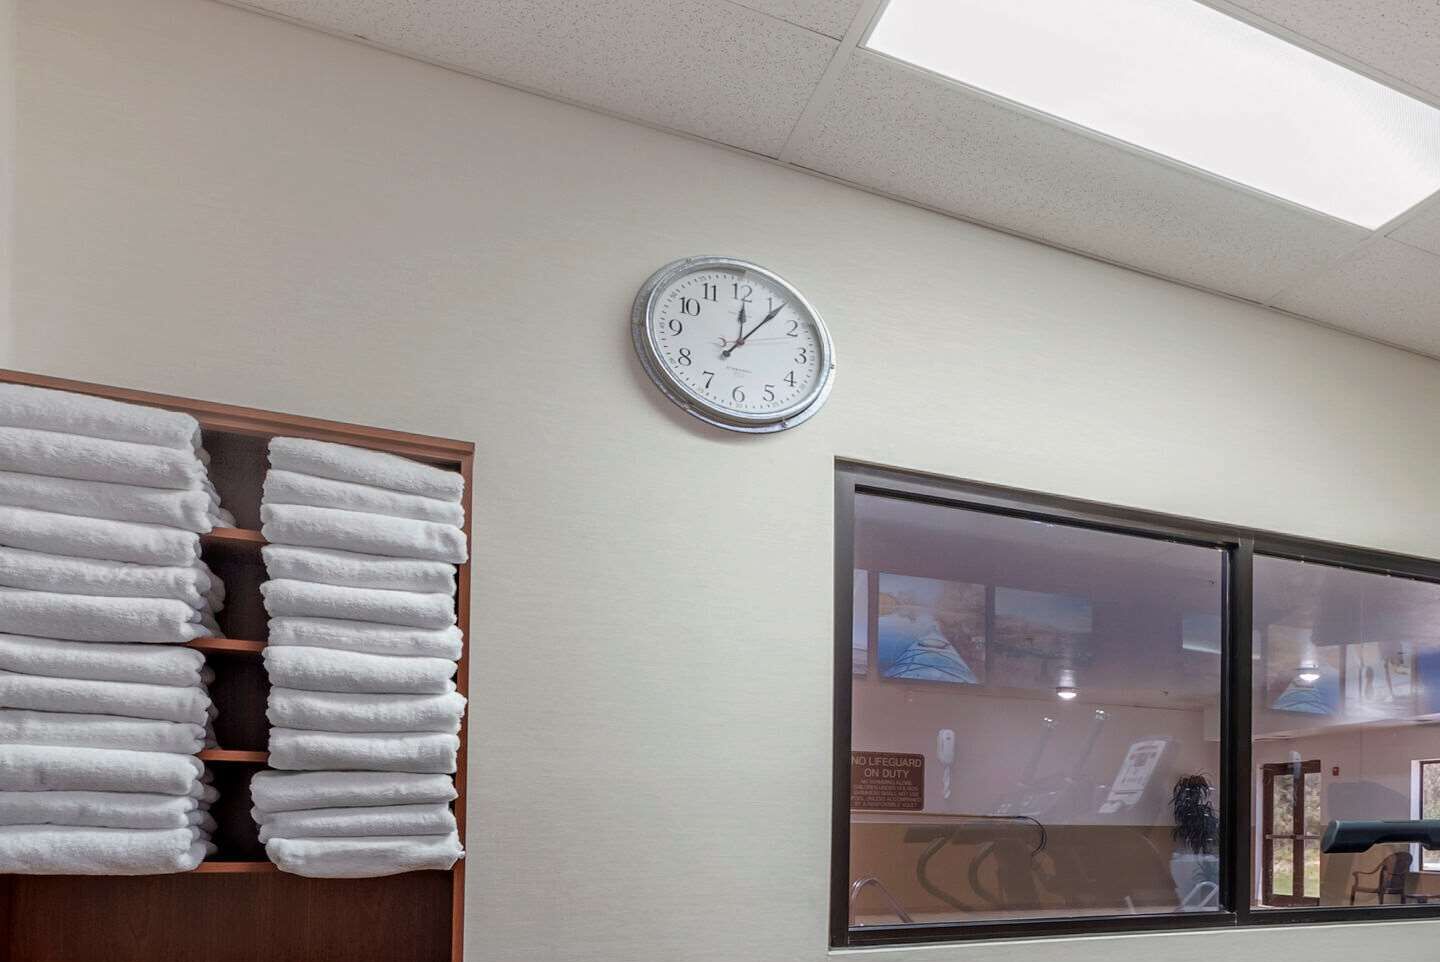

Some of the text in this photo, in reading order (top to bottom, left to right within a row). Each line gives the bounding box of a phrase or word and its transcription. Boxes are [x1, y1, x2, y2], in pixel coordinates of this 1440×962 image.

[702, 282, 718, 302] 11
[732, 283, 753, 303] 12
[680, 297, 701, 317] 10
[767, 297, 774, 313] 1
[669, 319, 683, 336] 9
[786, 320, 798, 337] 2
[678, 348, 692, 367] 8
[794, 347, 807, 365] 3
[702, 371, 715, 389] 7
[784, 370, 797, 387] 4
[732, 385, 745, 403] 6
[763, 384, 775, 402] 5
[853, 756, 921, 768] NO LIFEGUARD
[864, 767, 909, 778] ON DUTY
